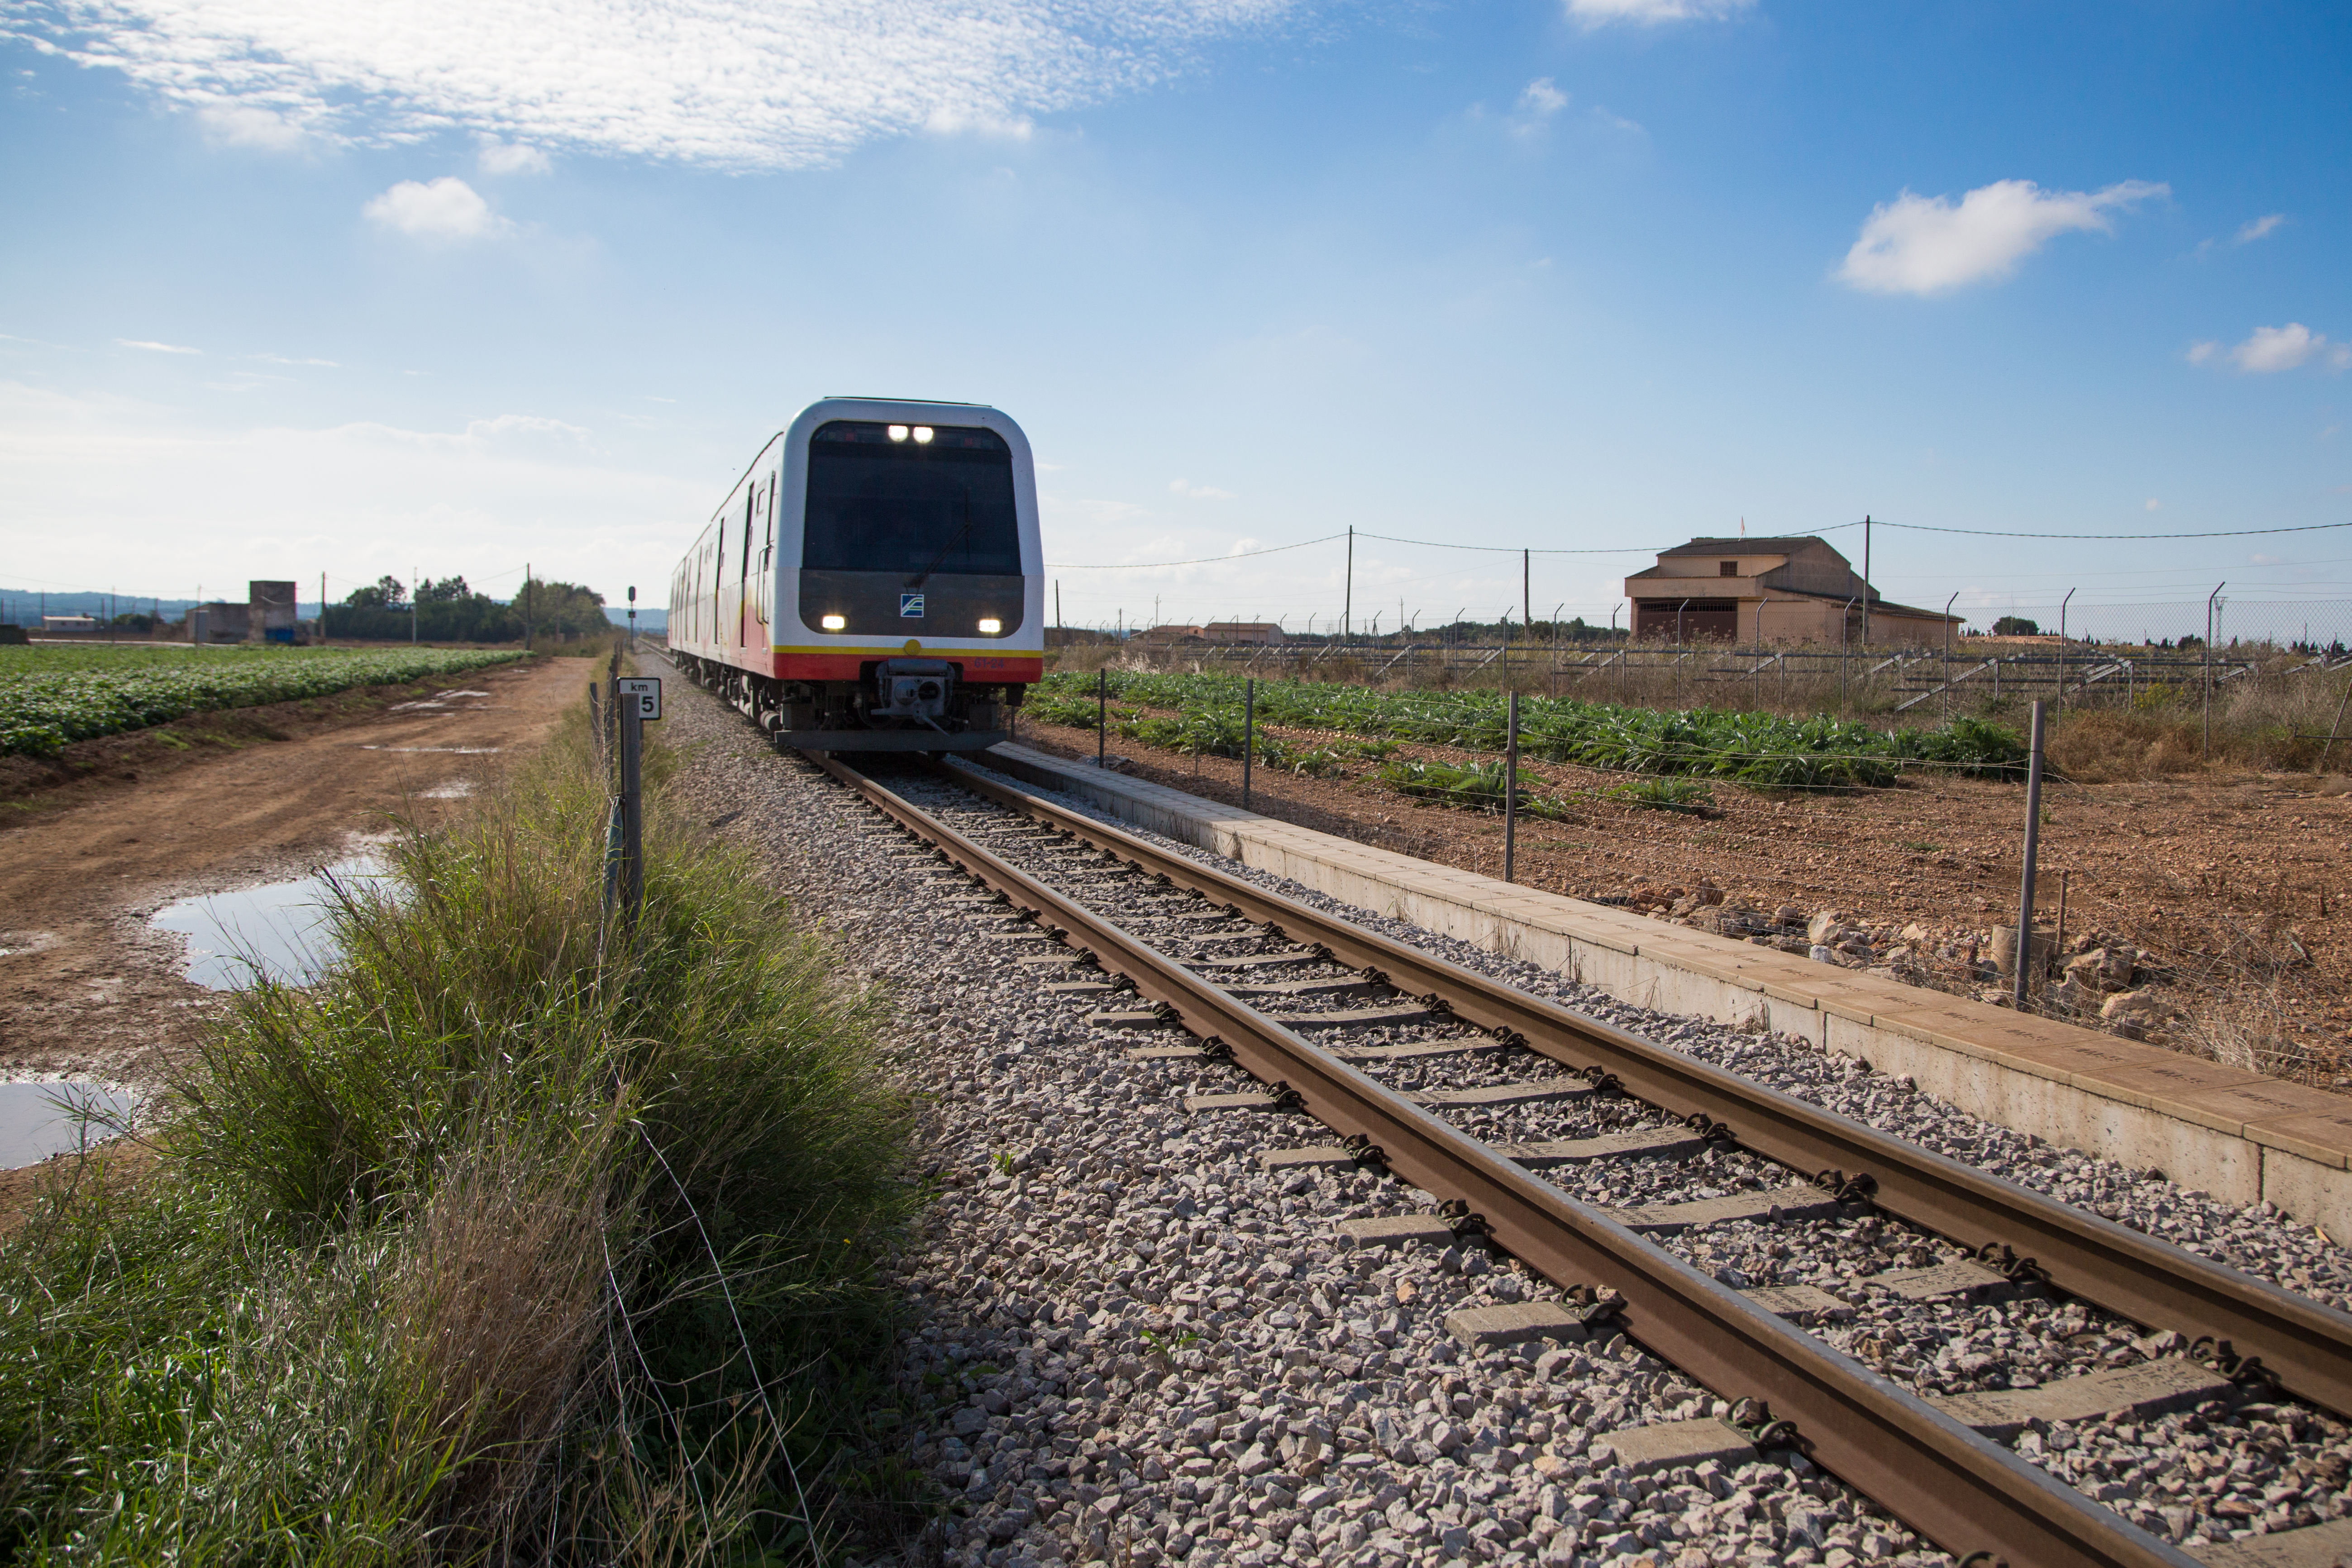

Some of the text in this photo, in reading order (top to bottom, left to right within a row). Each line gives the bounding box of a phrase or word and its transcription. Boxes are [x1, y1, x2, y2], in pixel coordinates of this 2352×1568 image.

[974, 658, 1004, 668] 61-24
[631, 682, 648, 691] km
[642, 696, 654, 712] 5
